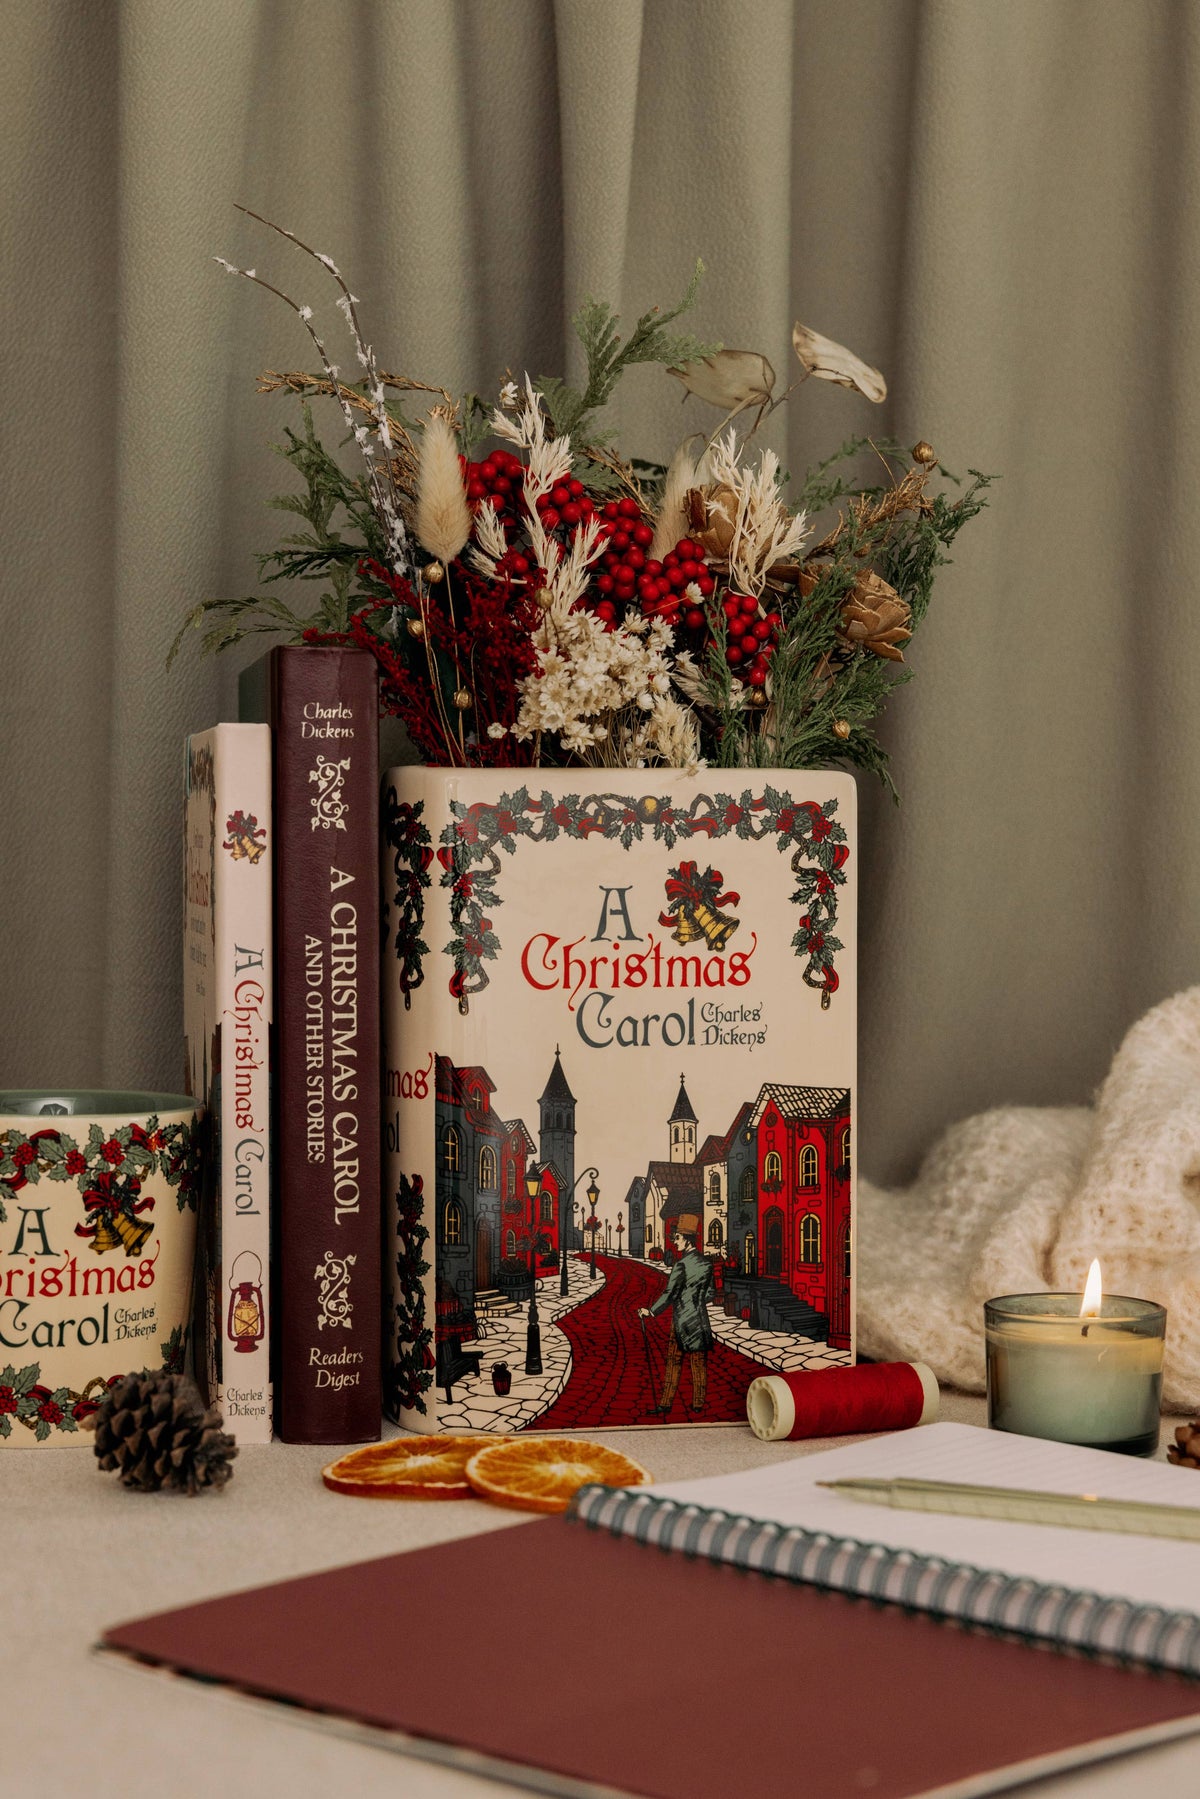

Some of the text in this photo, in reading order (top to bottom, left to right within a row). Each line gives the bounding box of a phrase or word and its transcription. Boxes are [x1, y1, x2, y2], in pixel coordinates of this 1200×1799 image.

[301, 721, 355, 739] Dickens
[303, 702, 353, 720] Charles
[589, 885, 644, 942] A
[520, 930, 757, 1011] Christmas
[576, 991, 696, 1048] Carol
[700, 1001, 763, 1026] Charles
[305, 934, 326, 1165] AND OTHER STORIES
[330, 865, 361, 1226] A CHRISTMAS CAROL
[700, 1024, 768, 1052] Dickens
[223, 943, 265, 1217] A Christmas Carol
[387, 1052, 433, 1100] mas
[8, 1206, 60, 1257] A
[0, 1240, 161, 1298] ristmas
[0, 1299, 110, 1348] Carol
[113, 1317, 159, 1341] Dickens
[114, 1302, 157, 1325] Charles
[226, 1387, 265, 1401] Charles
[315, 1369, 360, 1391] Digest
[228, 1402, 267, 1420] Dickens
